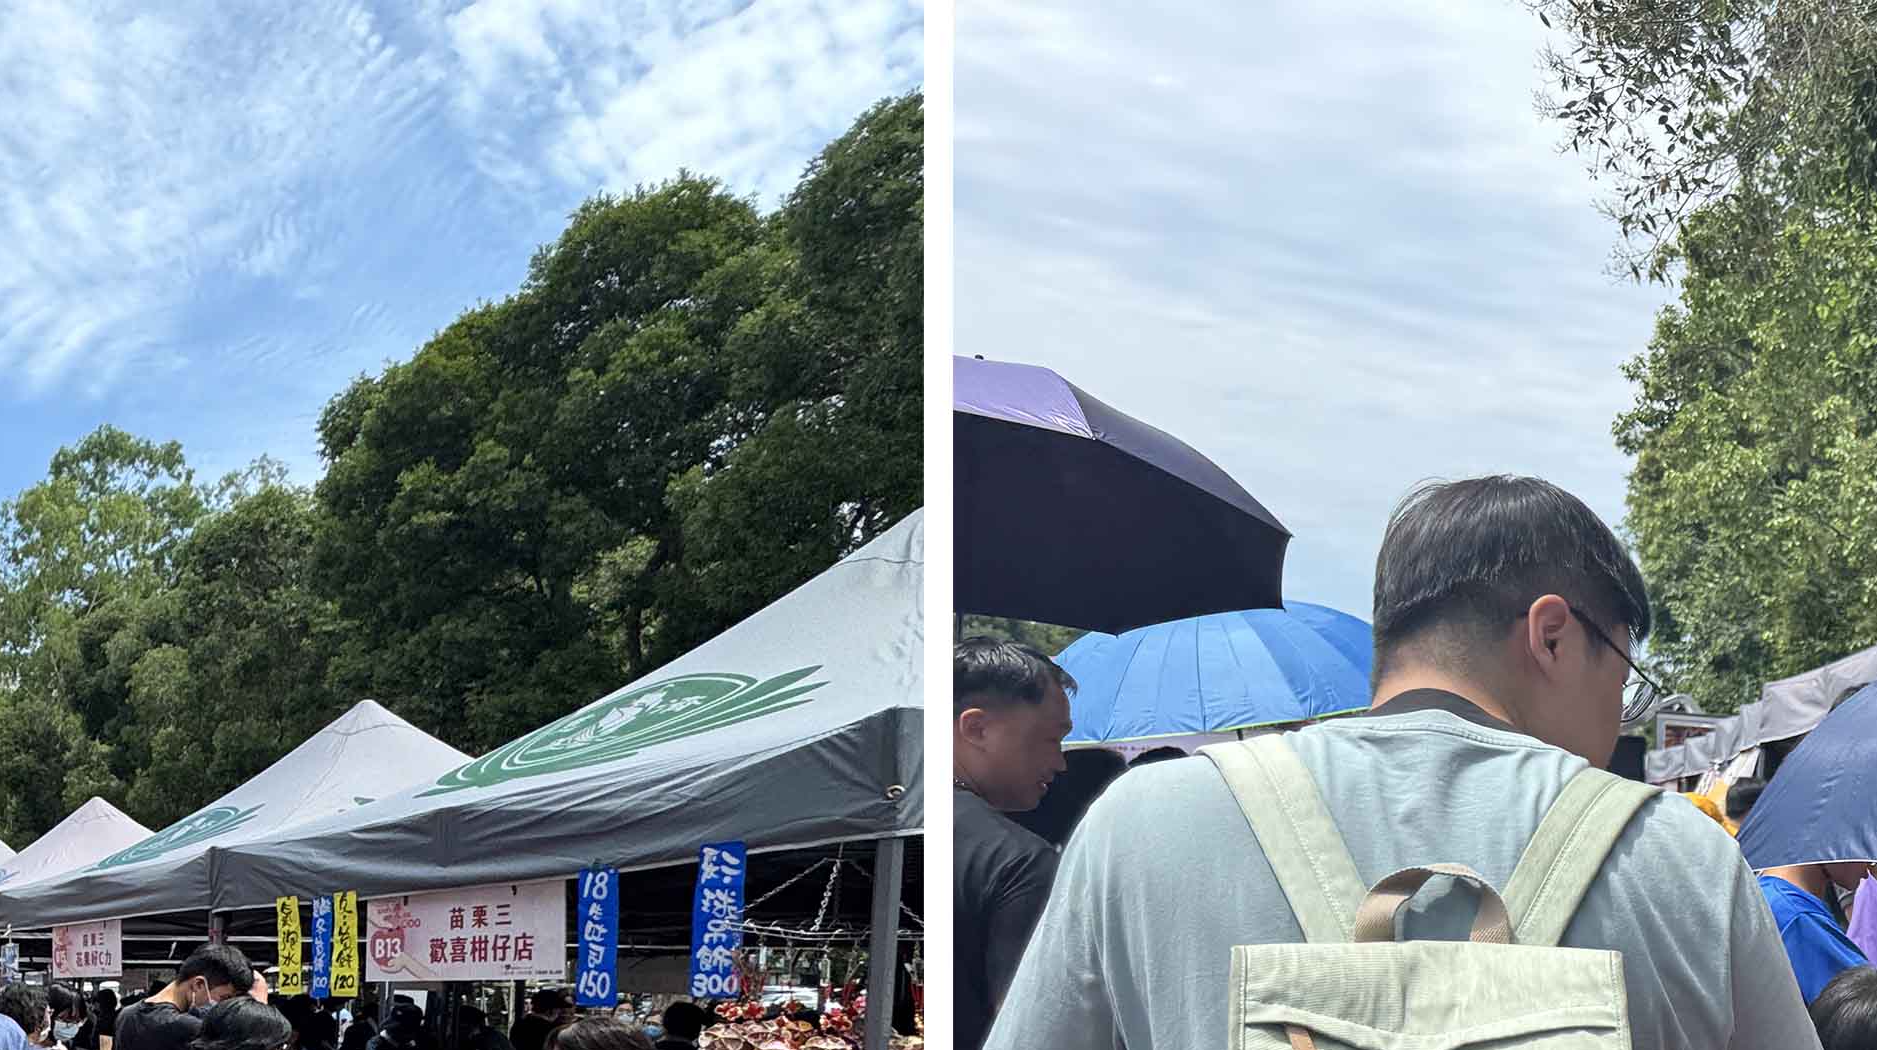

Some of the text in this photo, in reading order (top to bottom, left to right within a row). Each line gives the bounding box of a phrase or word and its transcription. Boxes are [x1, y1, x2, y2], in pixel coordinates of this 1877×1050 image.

[449, 904, 512, 930] 苗栗三
[375, 938, 401, 958] B13
[429, 932, 534, 964] 歡喜柑仔店
[281, 973, 299, 987] 20
[334, 974, 355, 990] 120
[579, 971, 610, 999] 150
[691, 972, 738, 998] 300
